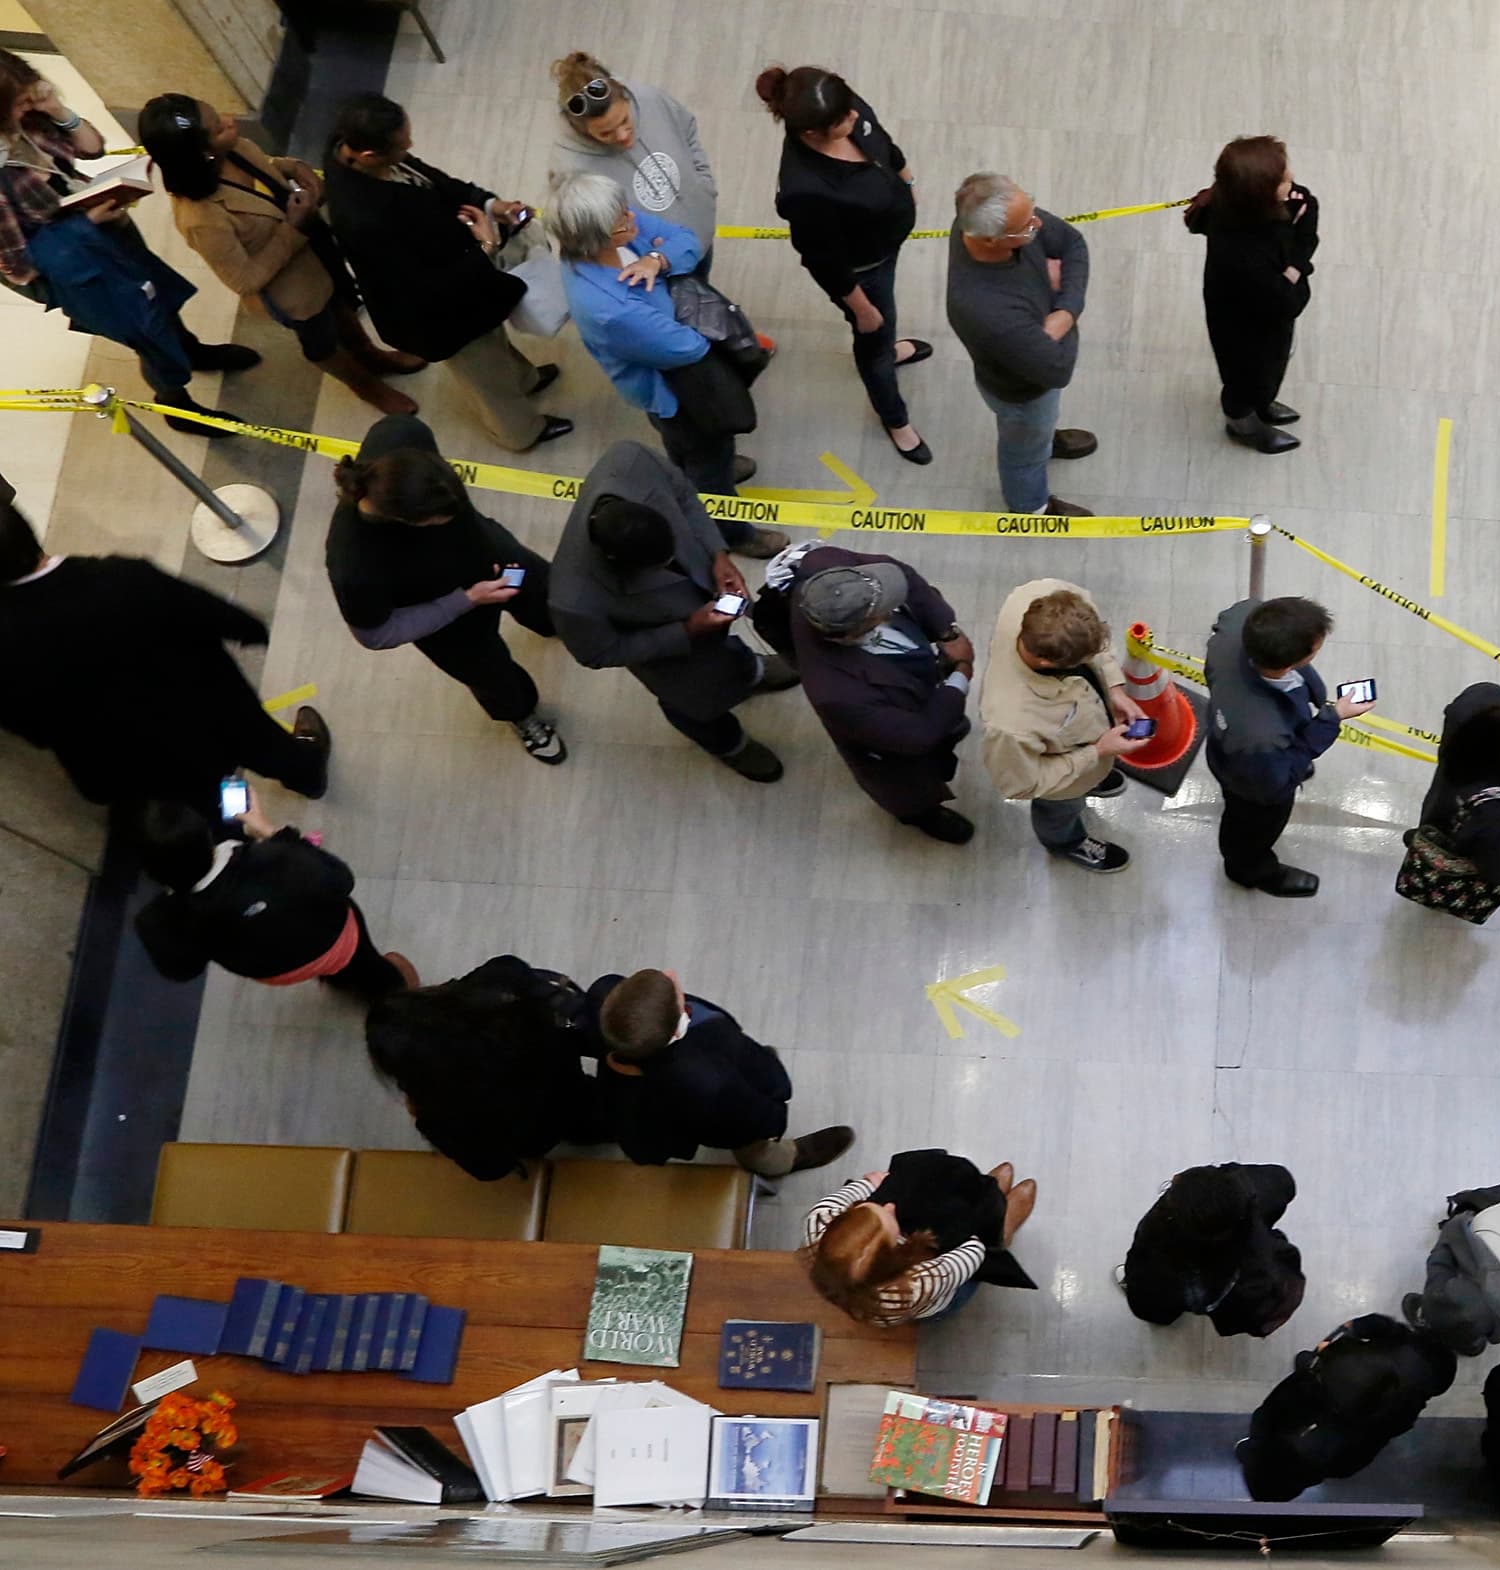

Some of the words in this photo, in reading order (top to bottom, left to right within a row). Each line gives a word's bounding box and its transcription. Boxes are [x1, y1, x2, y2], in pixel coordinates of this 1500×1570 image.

[704, 498, 779, 521] CAUTION
[851, 510, 925, 531] CAUTION
[997, 517, 1069, 533] CAUTION
[1141, 516, 1215, 531] CAUTION
[602, 1310, 613, 1330] I
[617, 1311, 666, 1334] WAR
[588, 1329, 674, 1354] WORLD
[977, 1462, 988, 1476] IN
